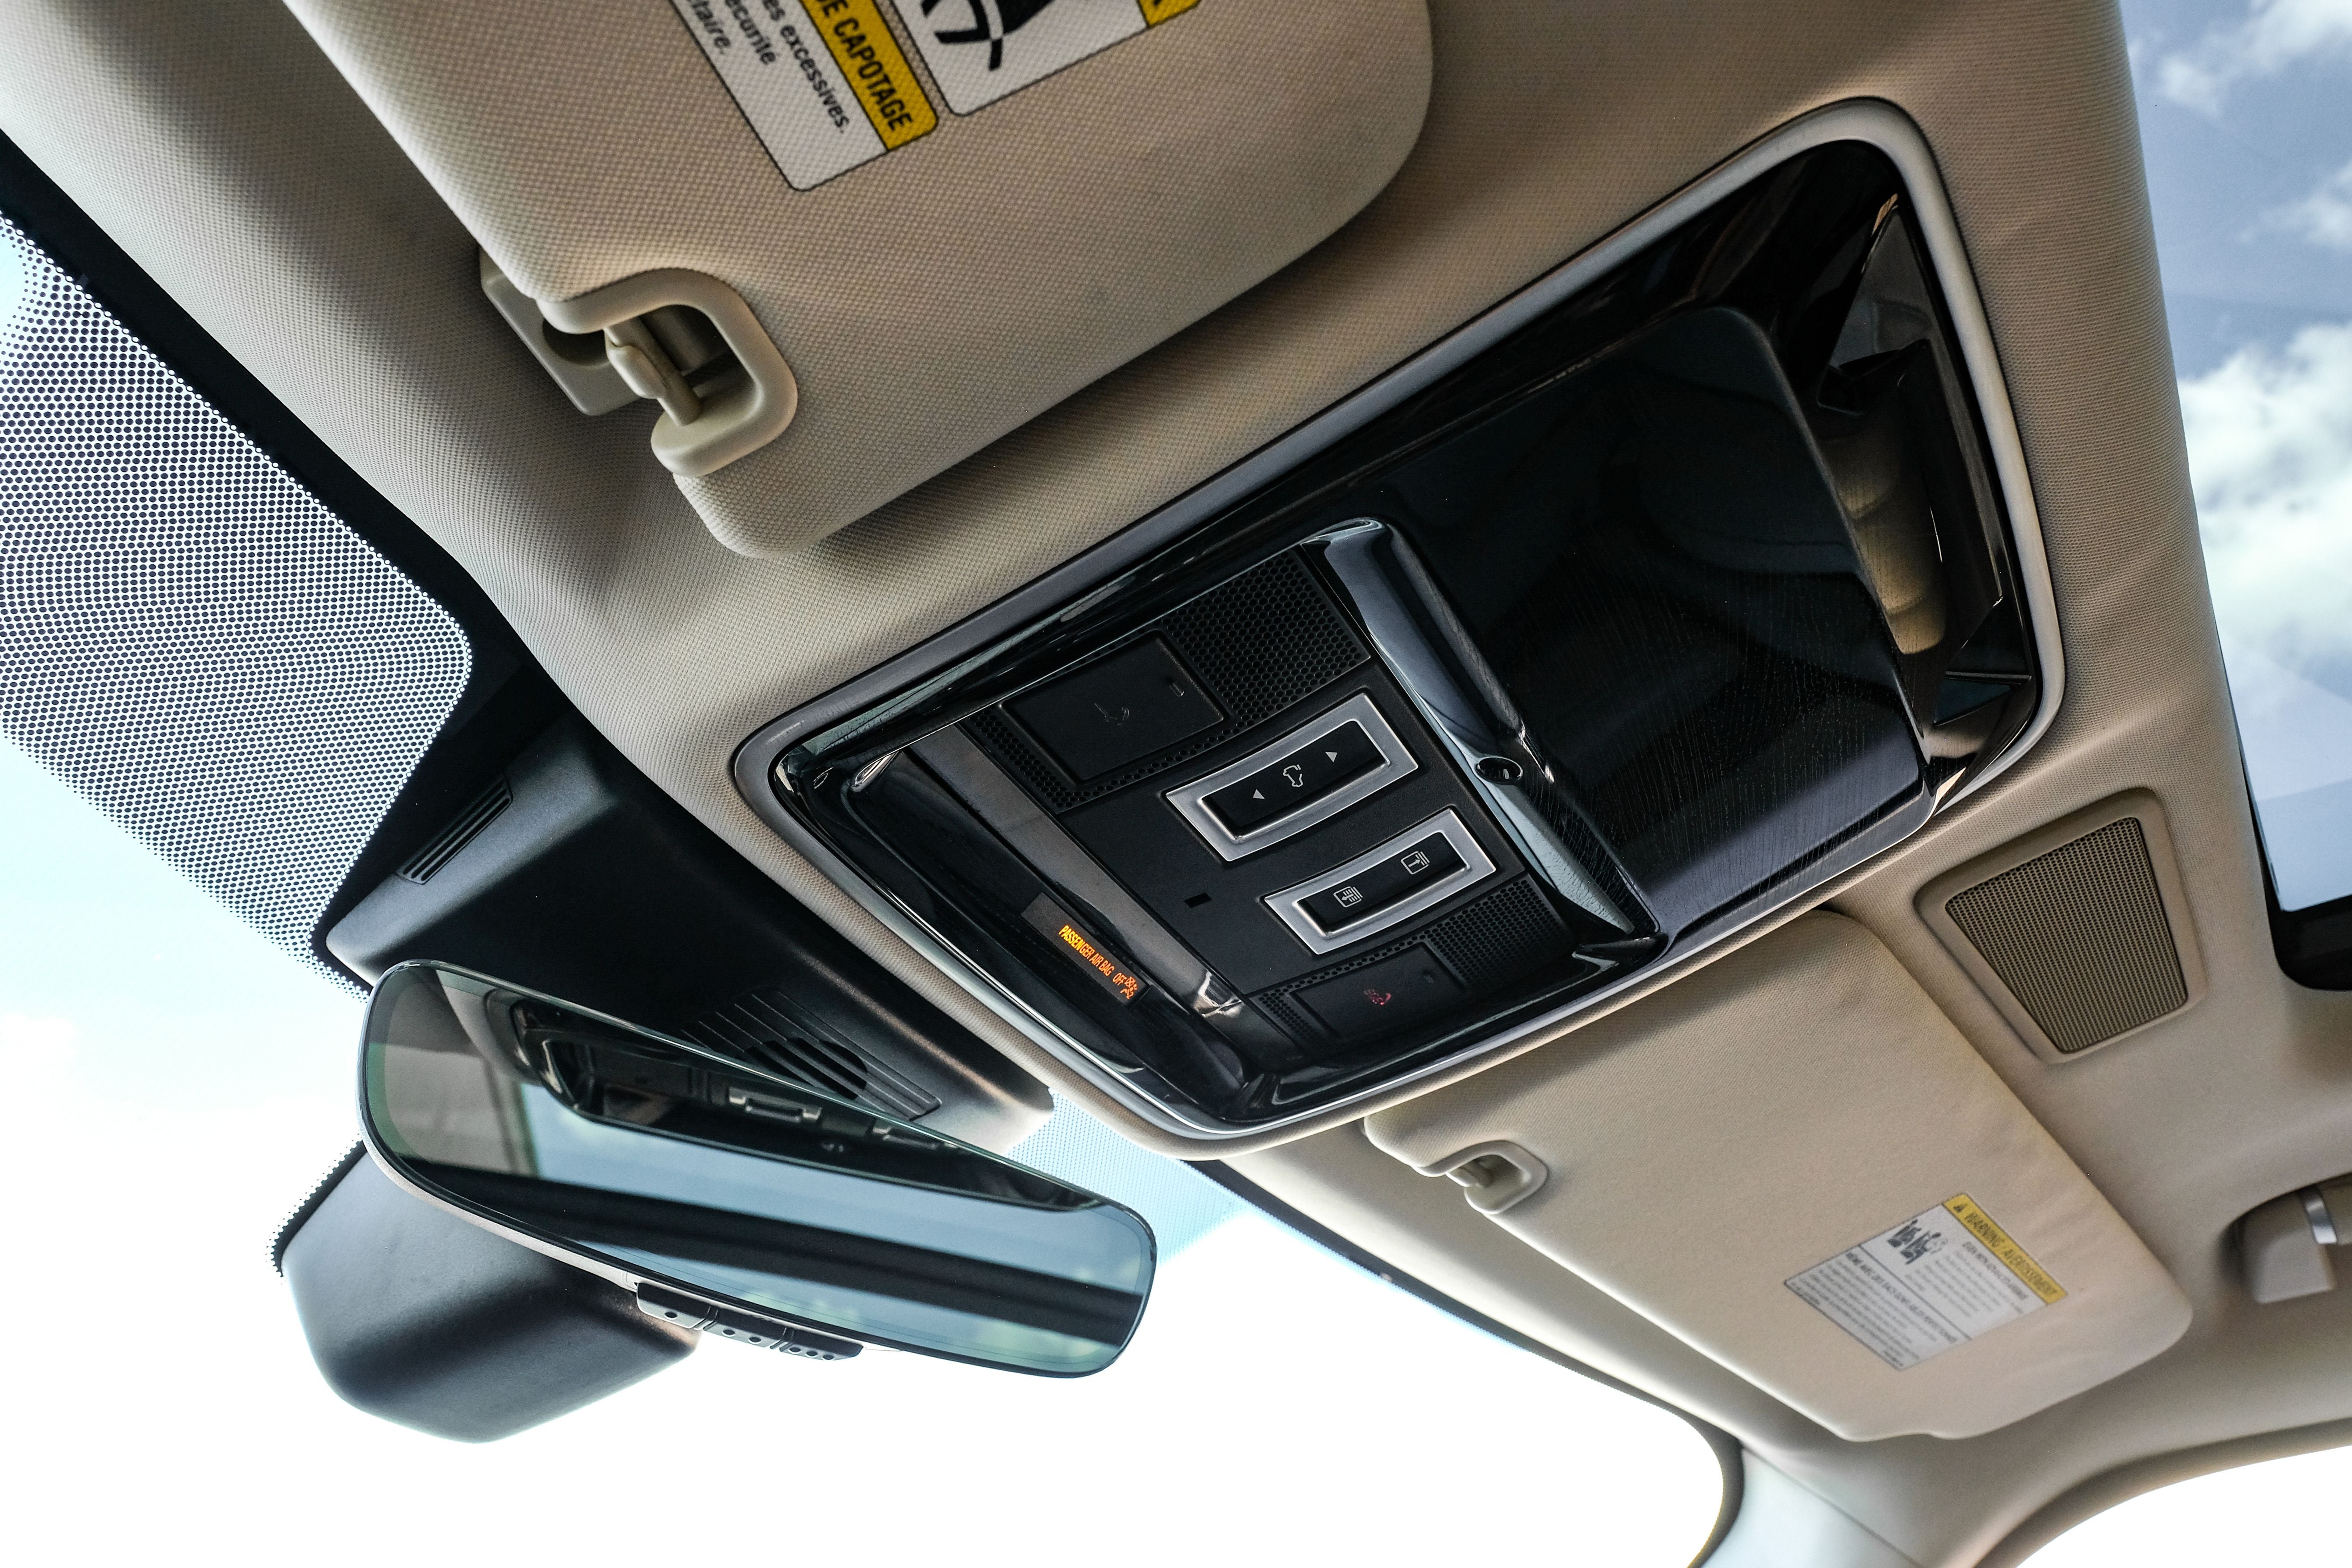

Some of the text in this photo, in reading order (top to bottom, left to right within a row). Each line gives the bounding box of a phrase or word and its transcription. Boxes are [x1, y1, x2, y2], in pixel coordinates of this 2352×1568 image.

[780, 25, 849, 134] excessives.
[834, 18, 913, 132] CAPOTAGE
[1058, 925, 1127, 986] PASSENGER AIR BAG OFF
